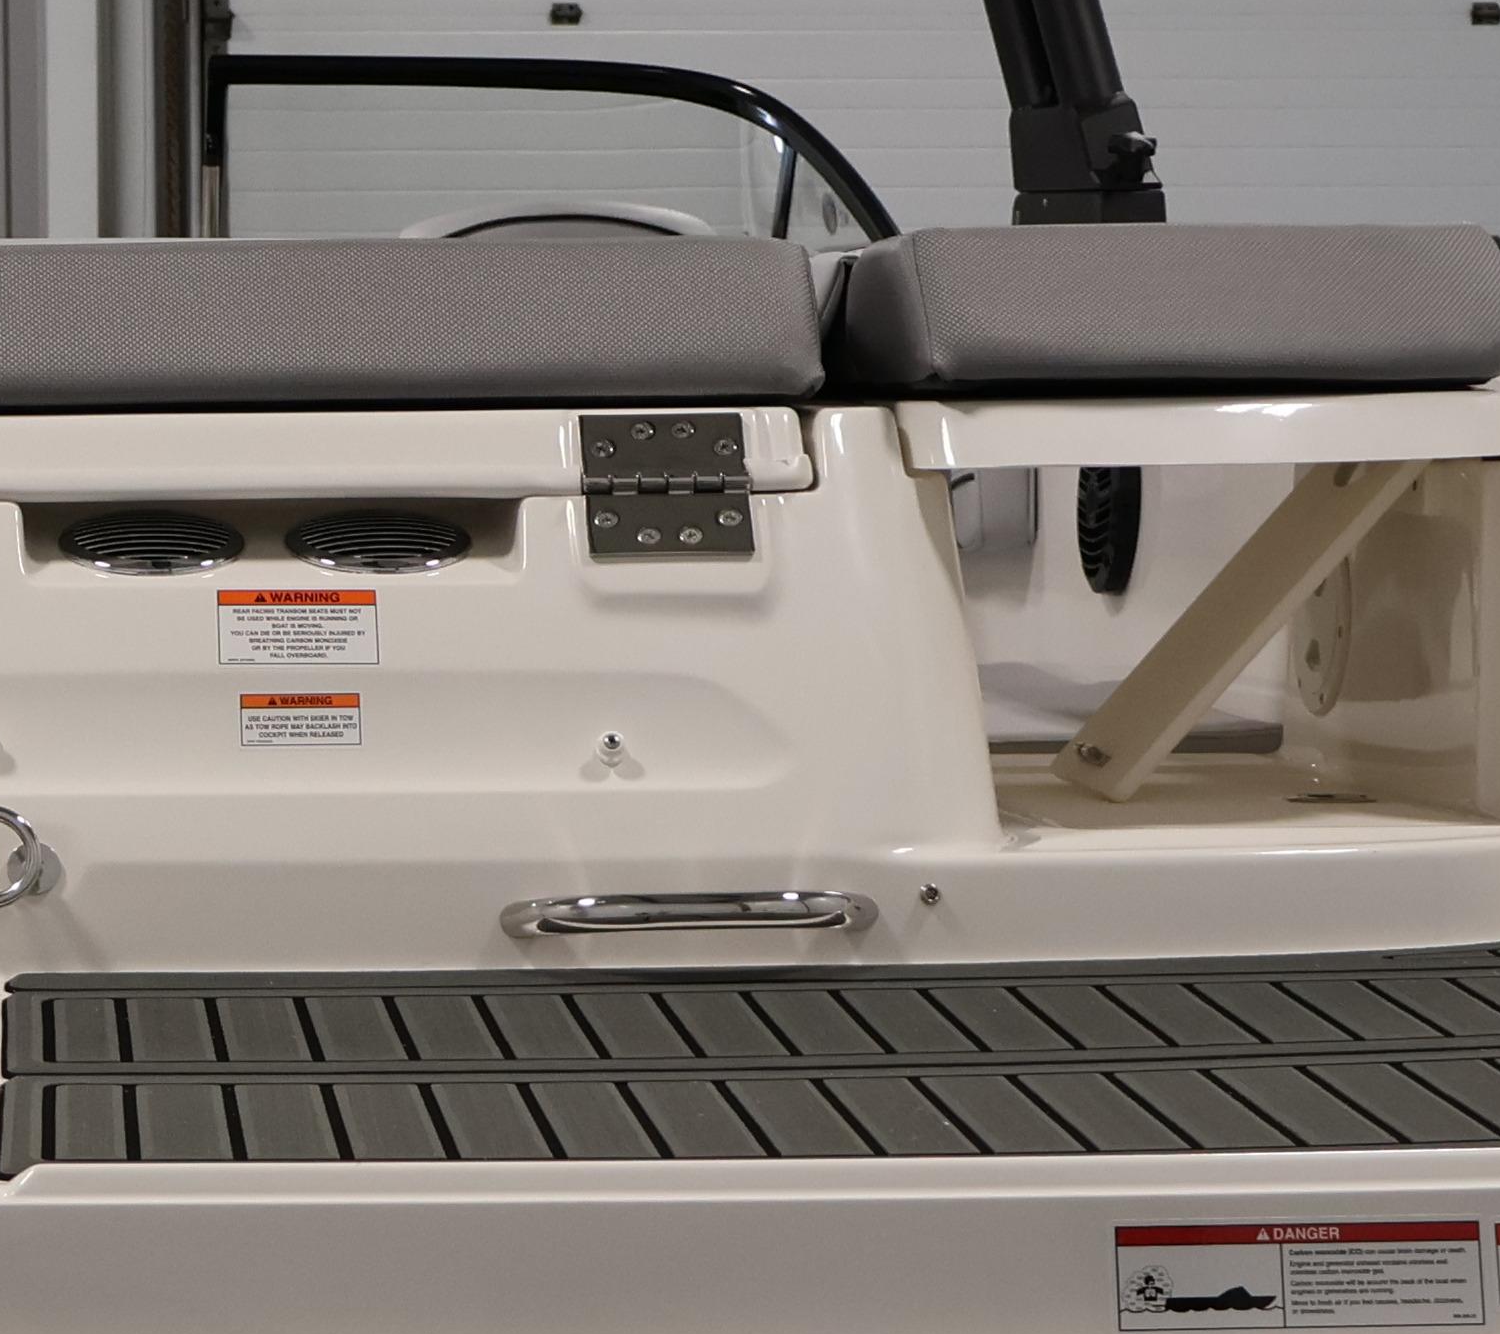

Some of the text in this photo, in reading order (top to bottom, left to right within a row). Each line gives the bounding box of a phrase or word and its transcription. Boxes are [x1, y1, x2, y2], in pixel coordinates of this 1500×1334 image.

[270, 592, 340, 603] WARNING
[279, 696, 333, 705] WARNING
[1273, 1226, 1340, 1240] DANGER
